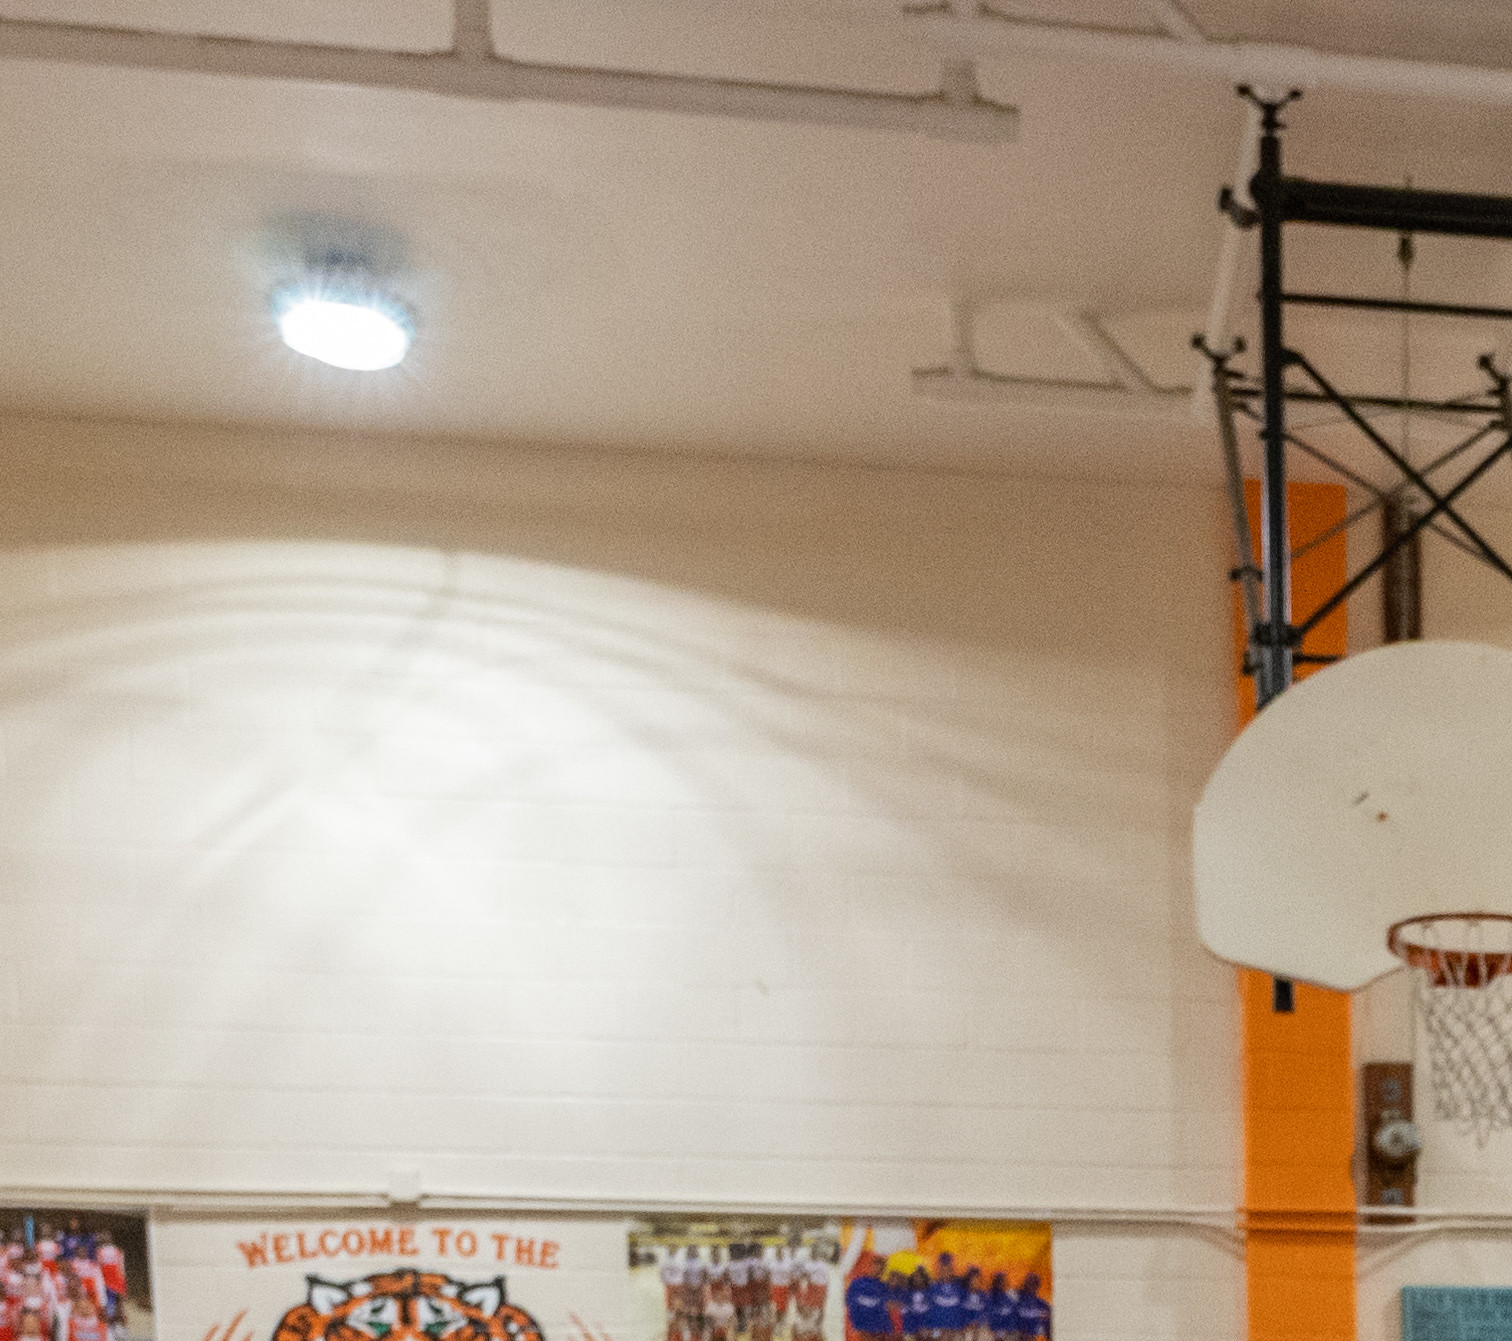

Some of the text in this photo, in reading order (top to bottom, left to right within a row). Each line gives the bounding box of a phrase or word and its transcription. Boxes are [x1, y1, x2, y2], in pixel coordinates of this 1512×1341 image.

[237, 1227, 560, 1269] WELCOME TO THE
